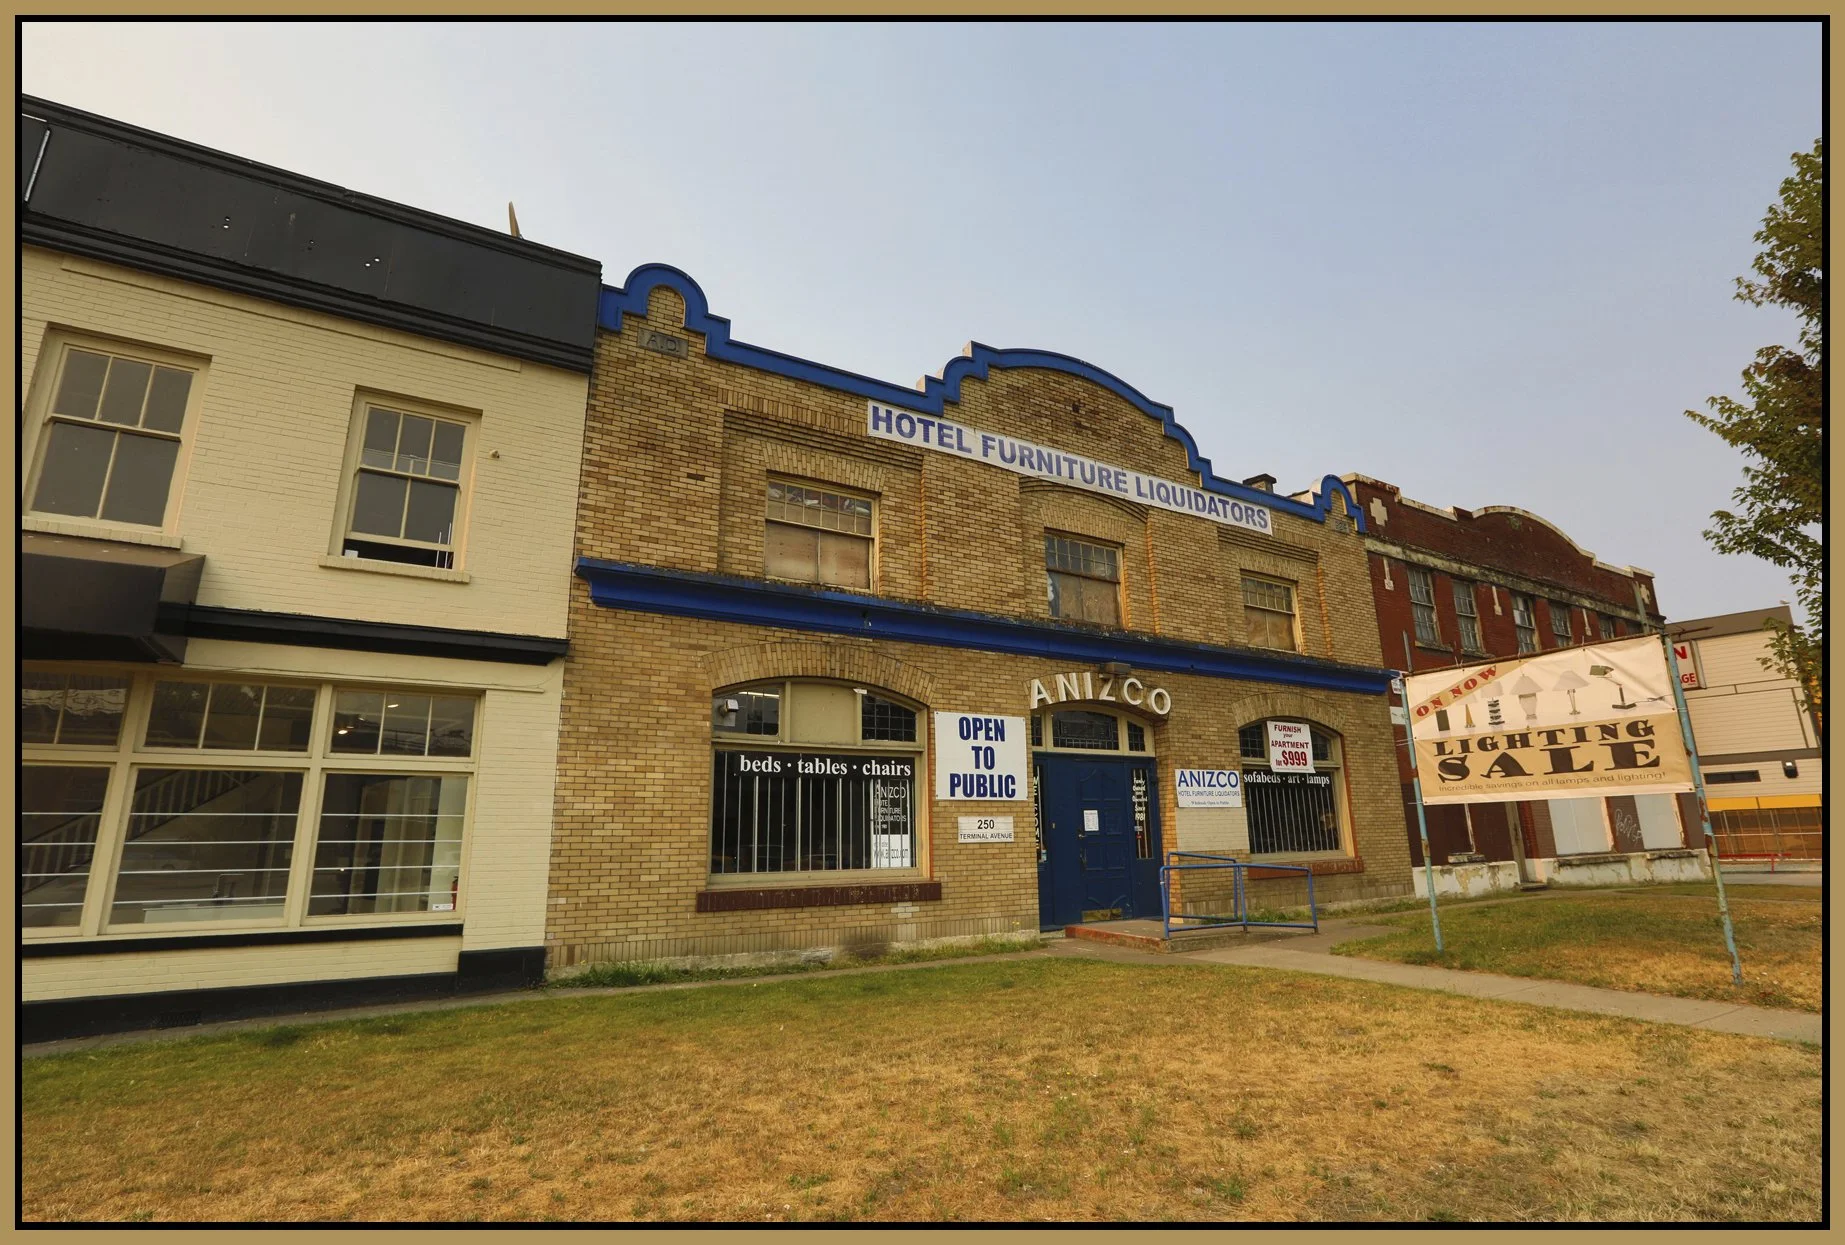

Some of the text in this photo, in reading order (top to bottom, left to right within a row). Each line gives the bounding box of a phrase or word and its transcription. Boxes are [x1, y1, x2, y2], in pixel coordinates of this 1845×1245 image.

[872, 405, 1269, 530] HOTEL FURNITURE LIQUIDATORS
[1030, 671, 1172, 716] ANIZCO
[1415, 664, 1497, 718] ON NOW
[958, 716, 1005, 742] OPEN
[1274, 724, 1301, 734] FURNISH
[1433, 718, 1655, 757] LIGHTING
[1271, 740, 1309, 749] APARTMENT
[740, 754, 911, 777] beds tables chairs
[971, 745, 995, 770] TO
[1282, 749, 1308, 767] $999
[1437, 739, 1661, 784] SALE
[949, 773, 1017, 799] PUBLIC
[1178, 770, 1239, 788] ANIZCO
[1243, 771, 1330, 787] sofabeds art lamps
[1485, 782, 1523, 790] savings
[1541, 776, 1554, 785] all
[1556, 775, 1590, 785] lamps
[1592, 775, 1615, 783] and
[1617, 771, 1666, 782] lighting!
[977, 819, 995, 830] 250
